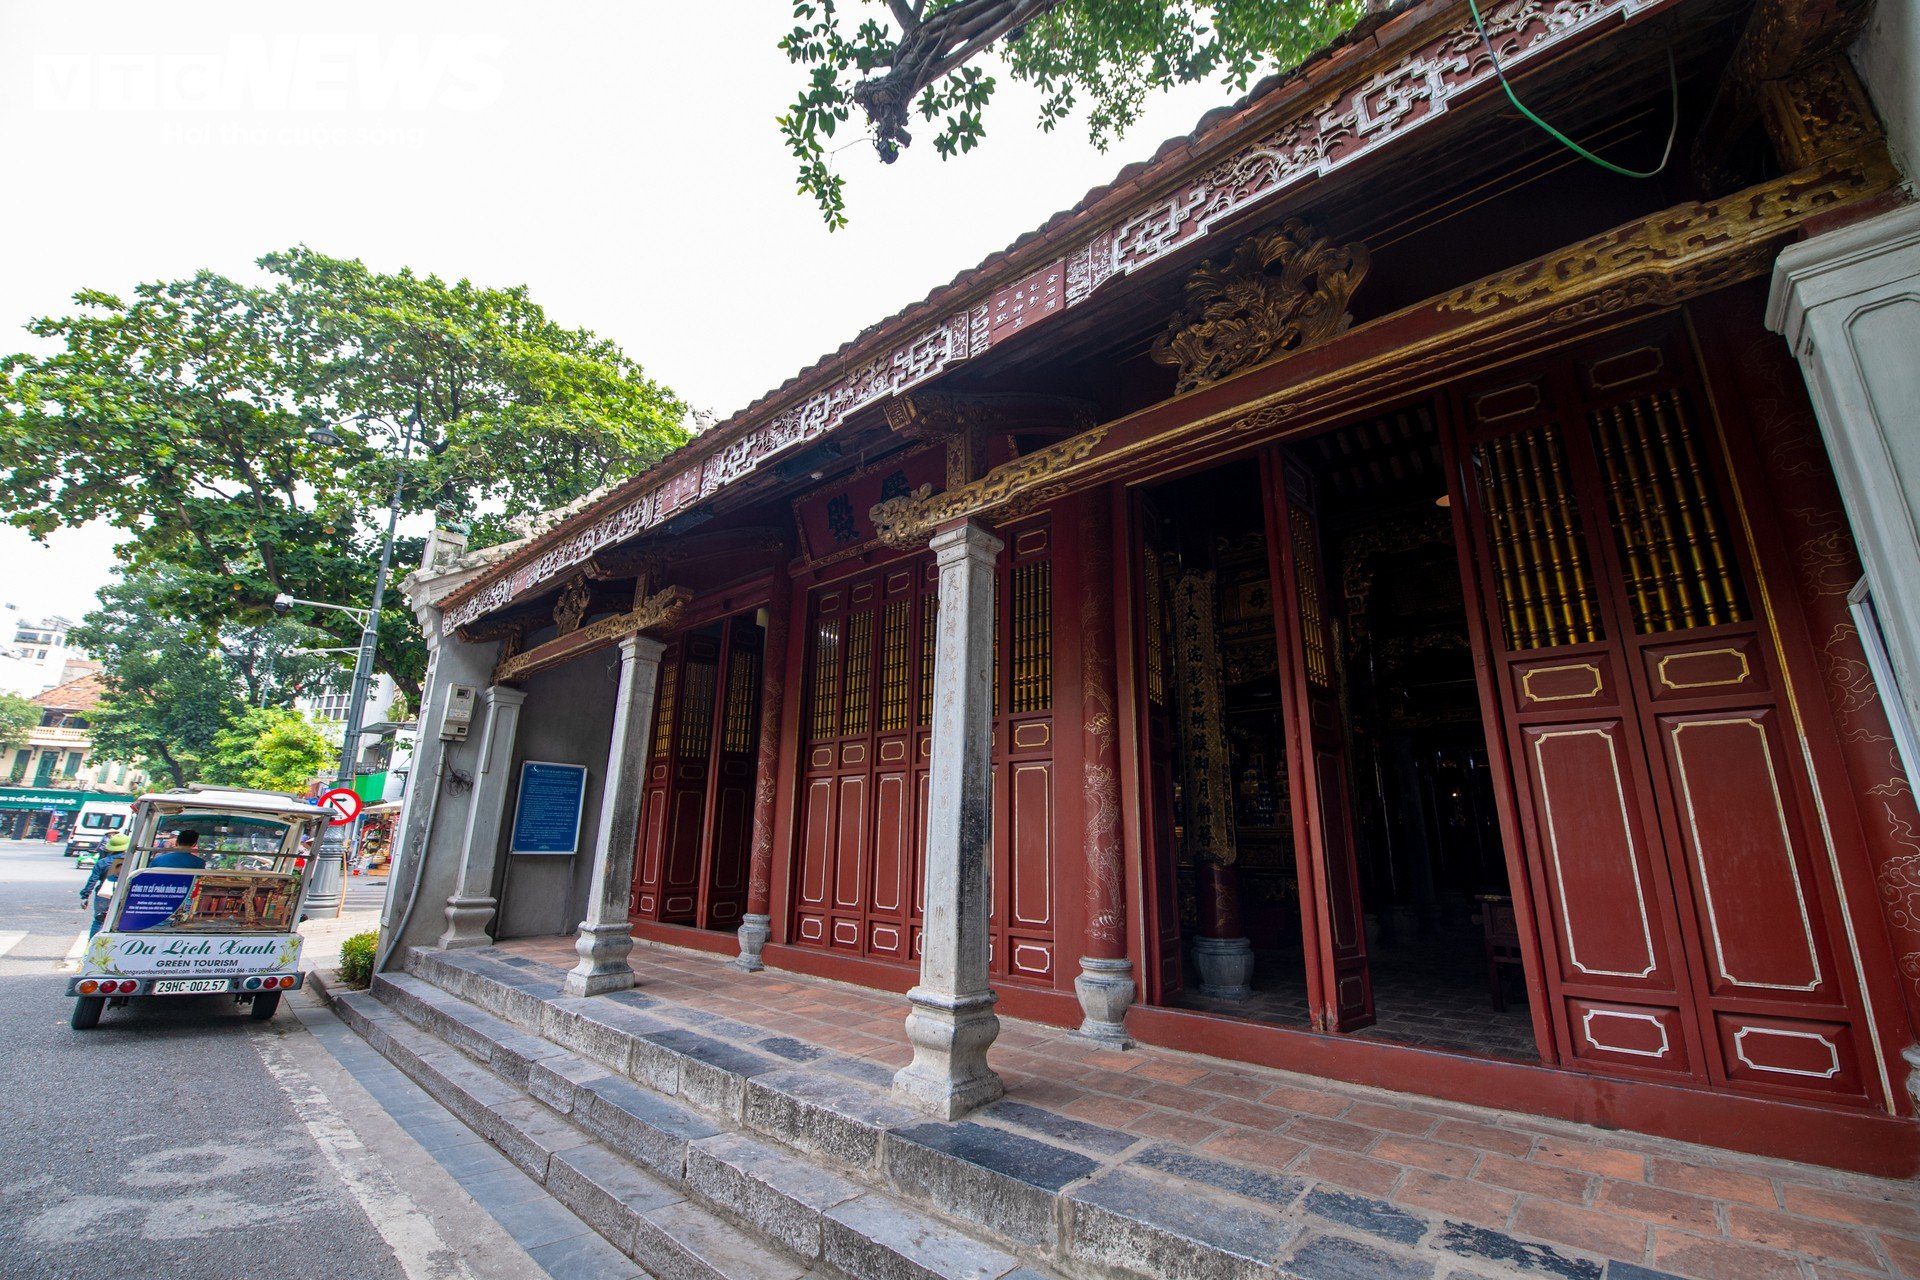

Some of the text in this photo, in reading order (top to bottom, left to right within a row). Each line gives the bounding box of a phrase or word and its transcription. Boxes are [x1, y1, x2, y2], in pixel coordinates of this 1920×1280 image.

[120, 940, 277, 958] Du Lịch Xanh
[156, 959, 239, 968] GREEN TOURISM
[157, 980, 226, 993] 29HC-002.57
